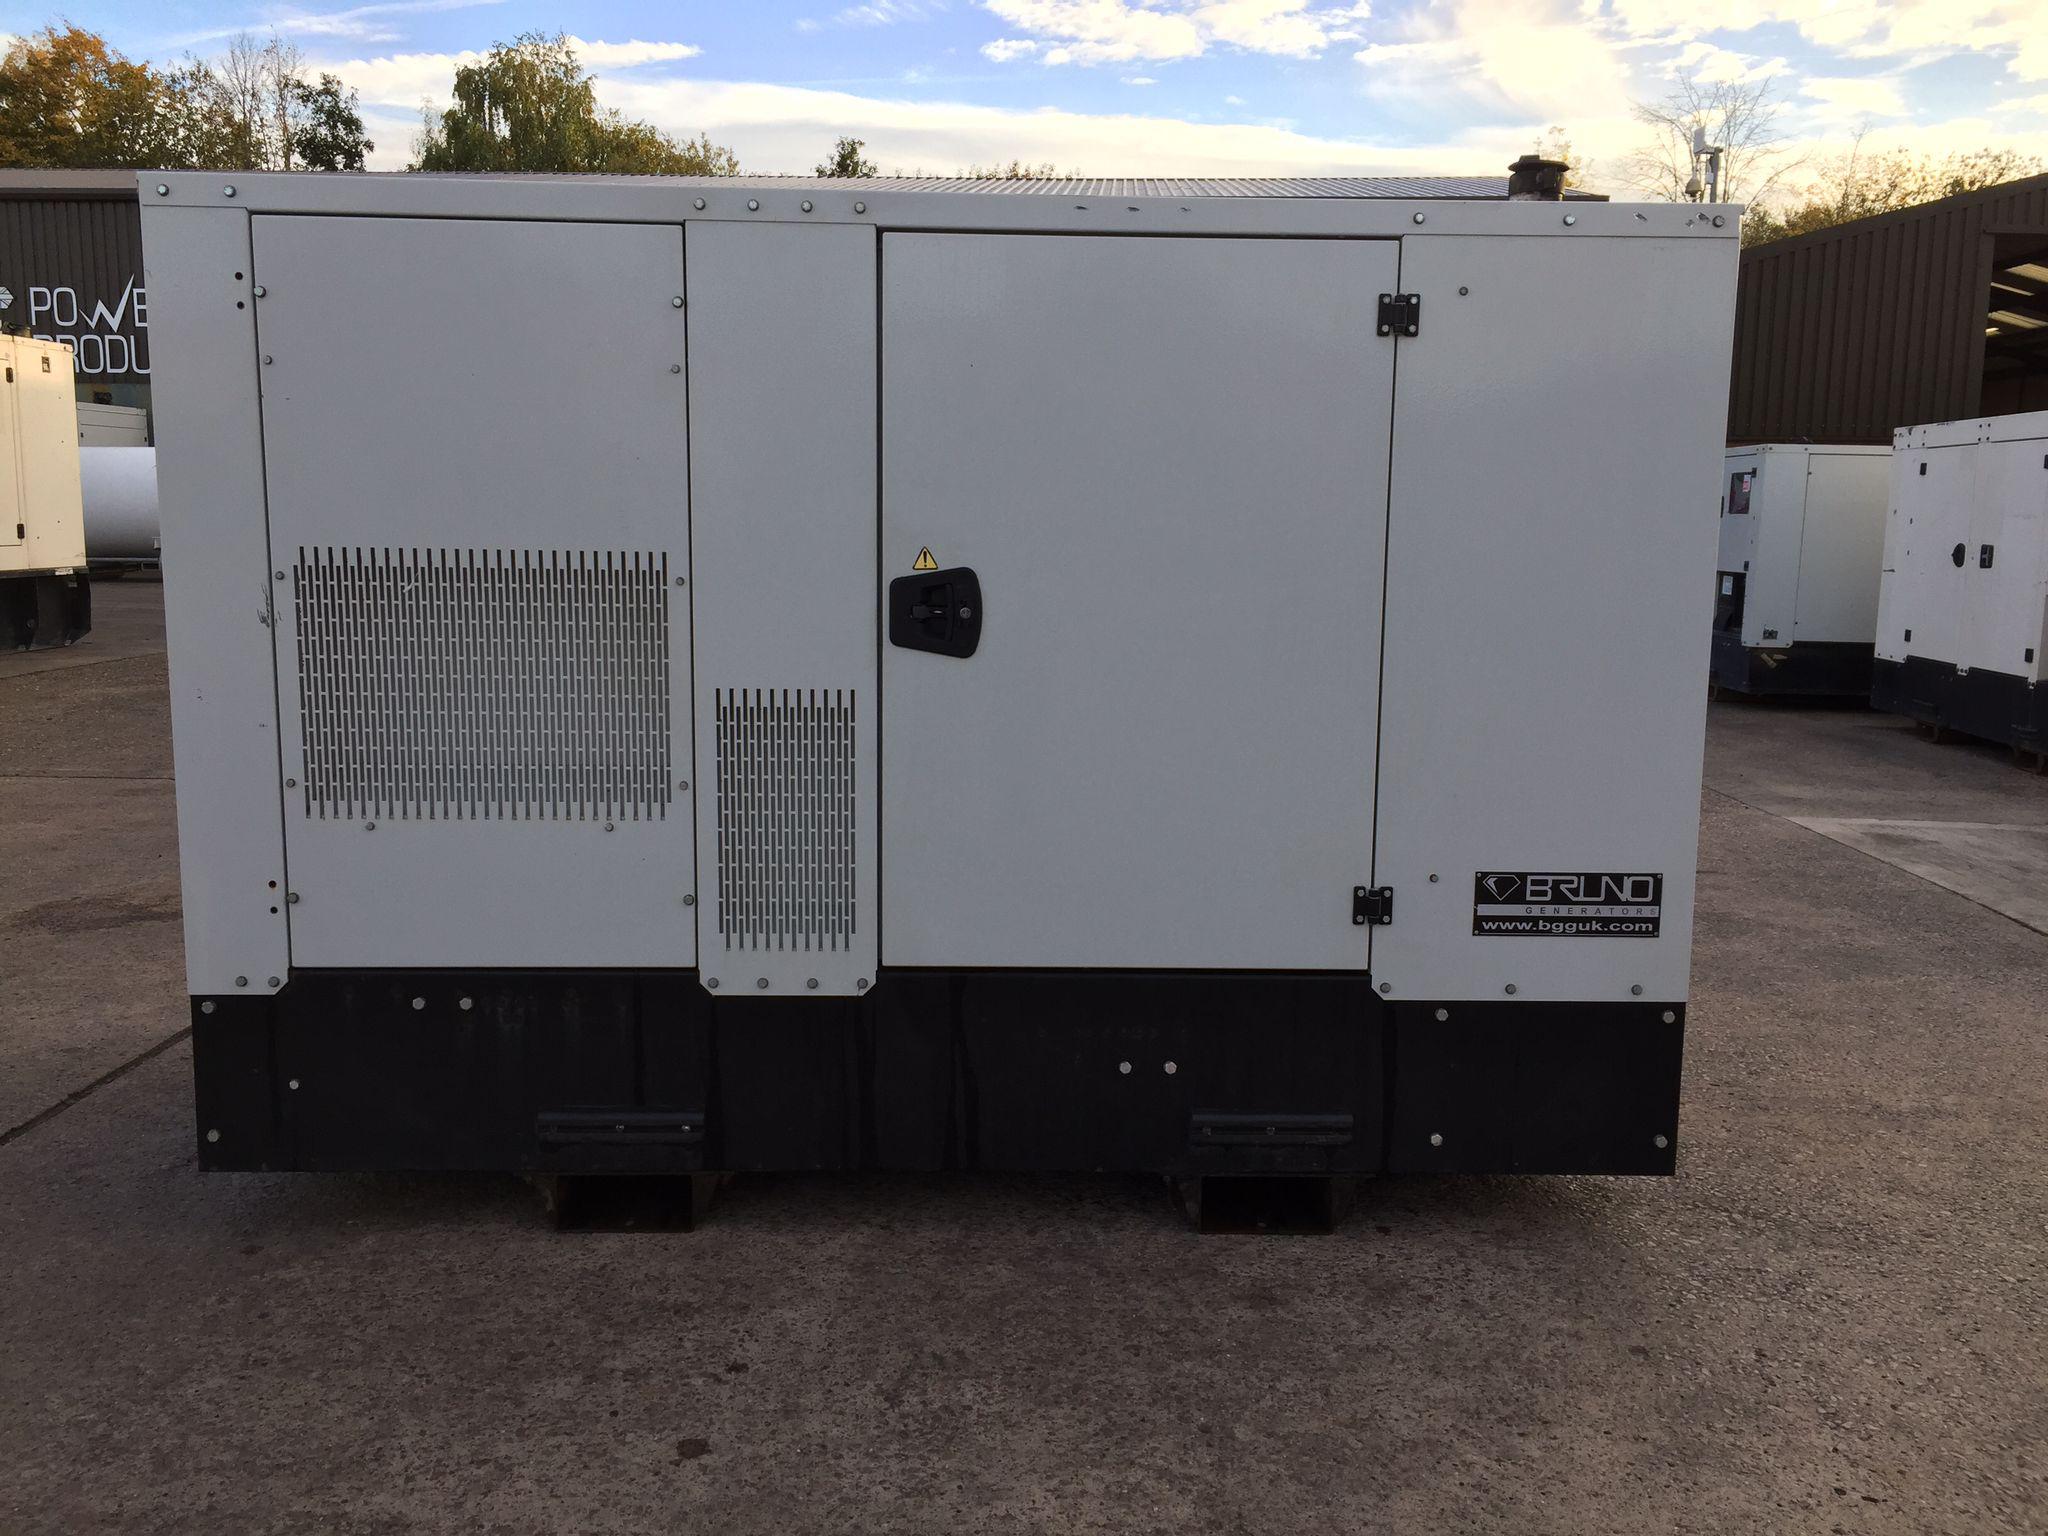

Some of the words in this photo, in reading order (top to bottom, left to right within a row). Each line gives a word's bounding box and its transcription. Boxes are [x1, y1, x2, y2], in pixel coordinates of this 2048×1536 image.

[33, 334, 150, 374] RODU
[1526, 875, 1654, 902] BRUNO
[1526, 906, 1657, 916] GENERATORS
[1482, 919, 1653, 933] www.bgguk.com
